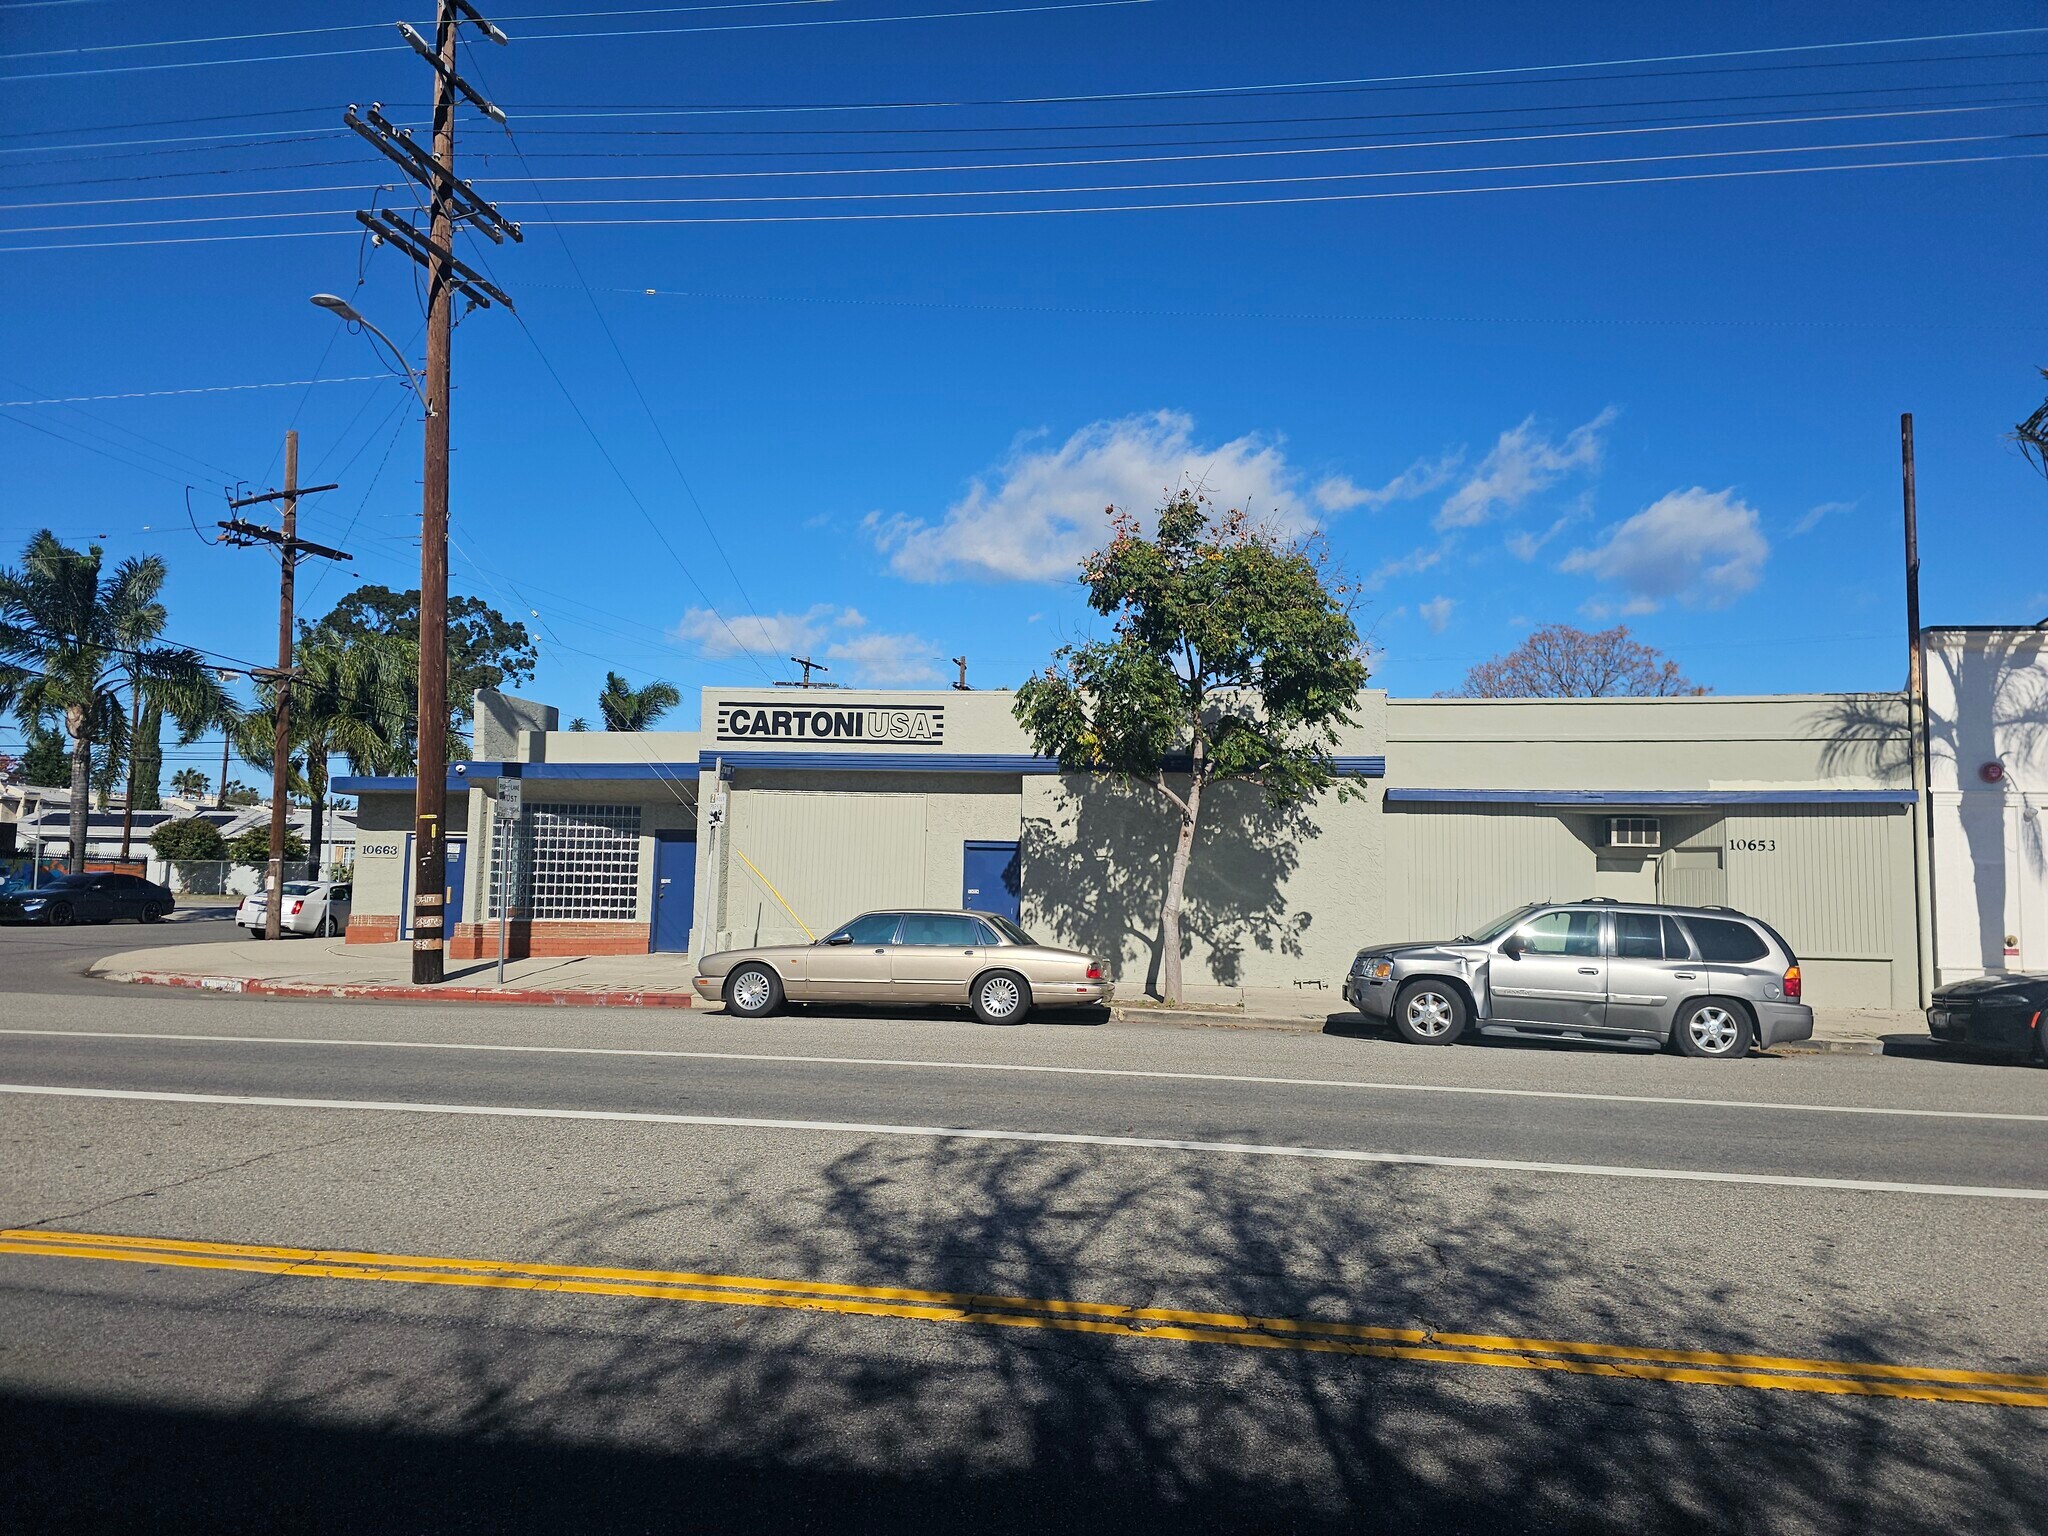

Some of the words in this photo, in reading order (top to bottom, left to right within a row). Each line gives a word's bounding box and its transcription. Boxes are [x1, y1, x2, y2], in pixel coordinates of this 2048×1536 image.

[729, 709, 864, 738] CARTONI
[867, 711, 932, 739] USA
[362, 845, 398, 855] 10663
[1729, 839, 1776, 851] 10653
